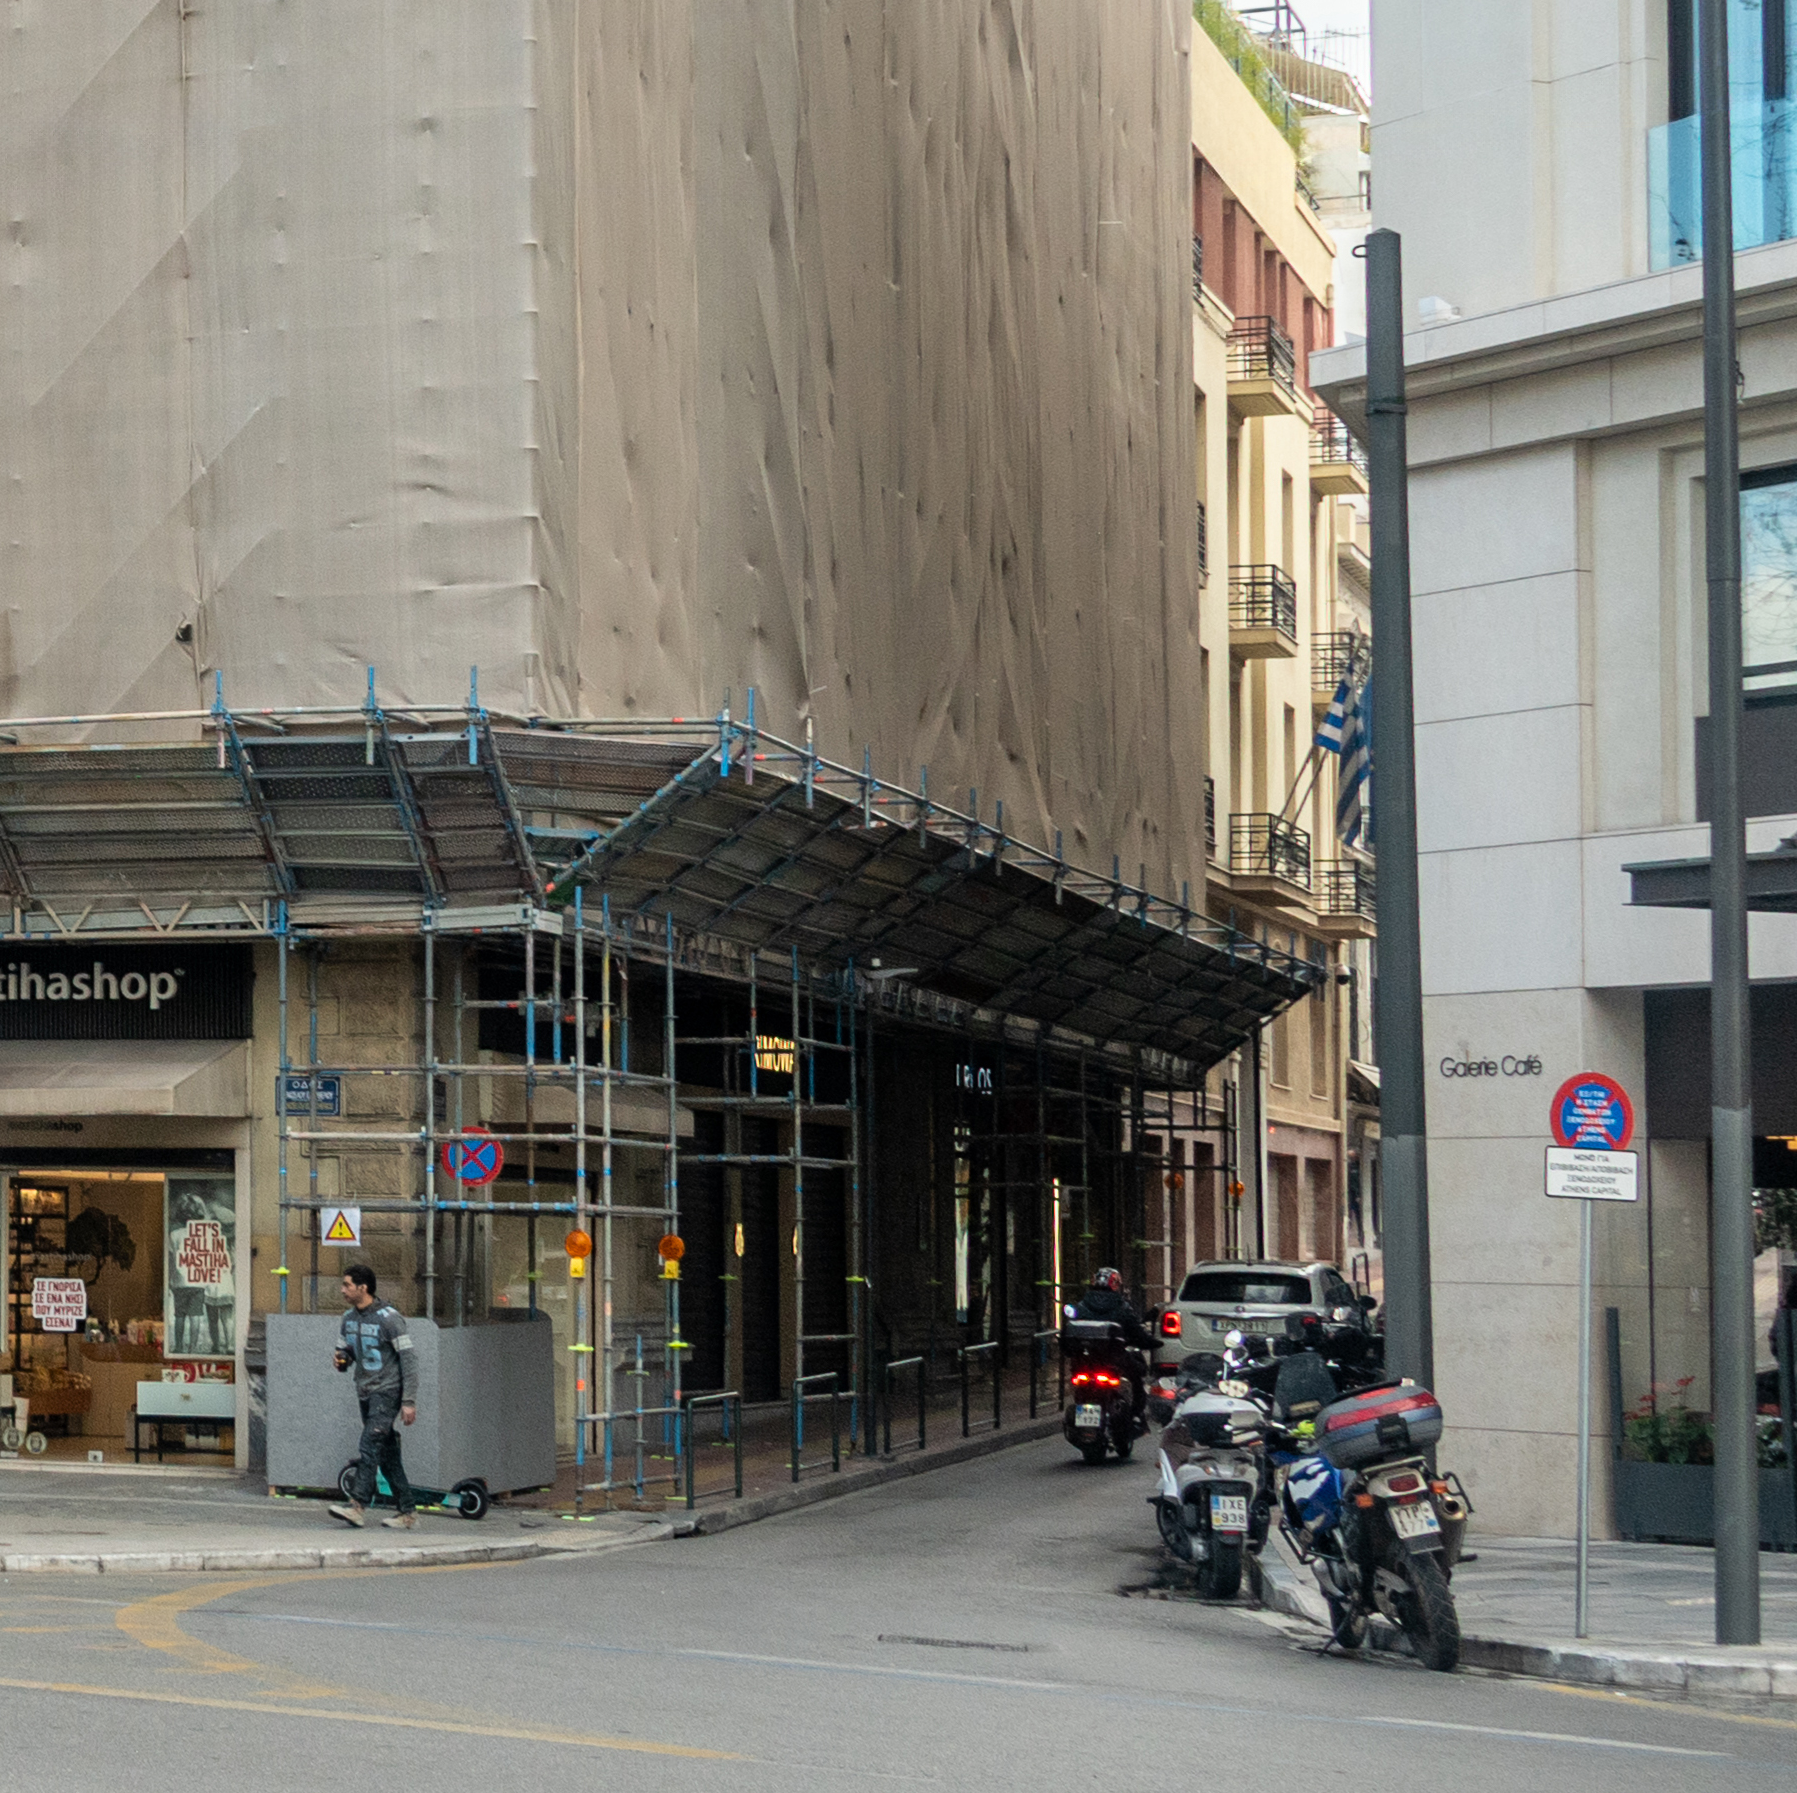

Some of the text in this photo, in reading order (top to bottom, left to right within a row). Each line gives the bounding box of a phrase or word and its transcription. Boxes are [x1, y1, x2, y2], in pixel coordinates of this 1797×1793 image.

[1440, 1054, 1543, 1078] Galerie Café
[291, 1080, 324, 1089] ΟΔΣ
[189, 1223, 219, 1238] LET'S
[184, 1238, 225, 1253] FALL IN
[179, 1253, 229, 1269] MASTIHA
[188, 1268, 221, 1284] LOVE!
[47, 1293, 63, 1304] ΕΝΑ
[35, 1305, 51, 1316] ΠΟΥ
[1221, 1512, 1246, 1524] 938
